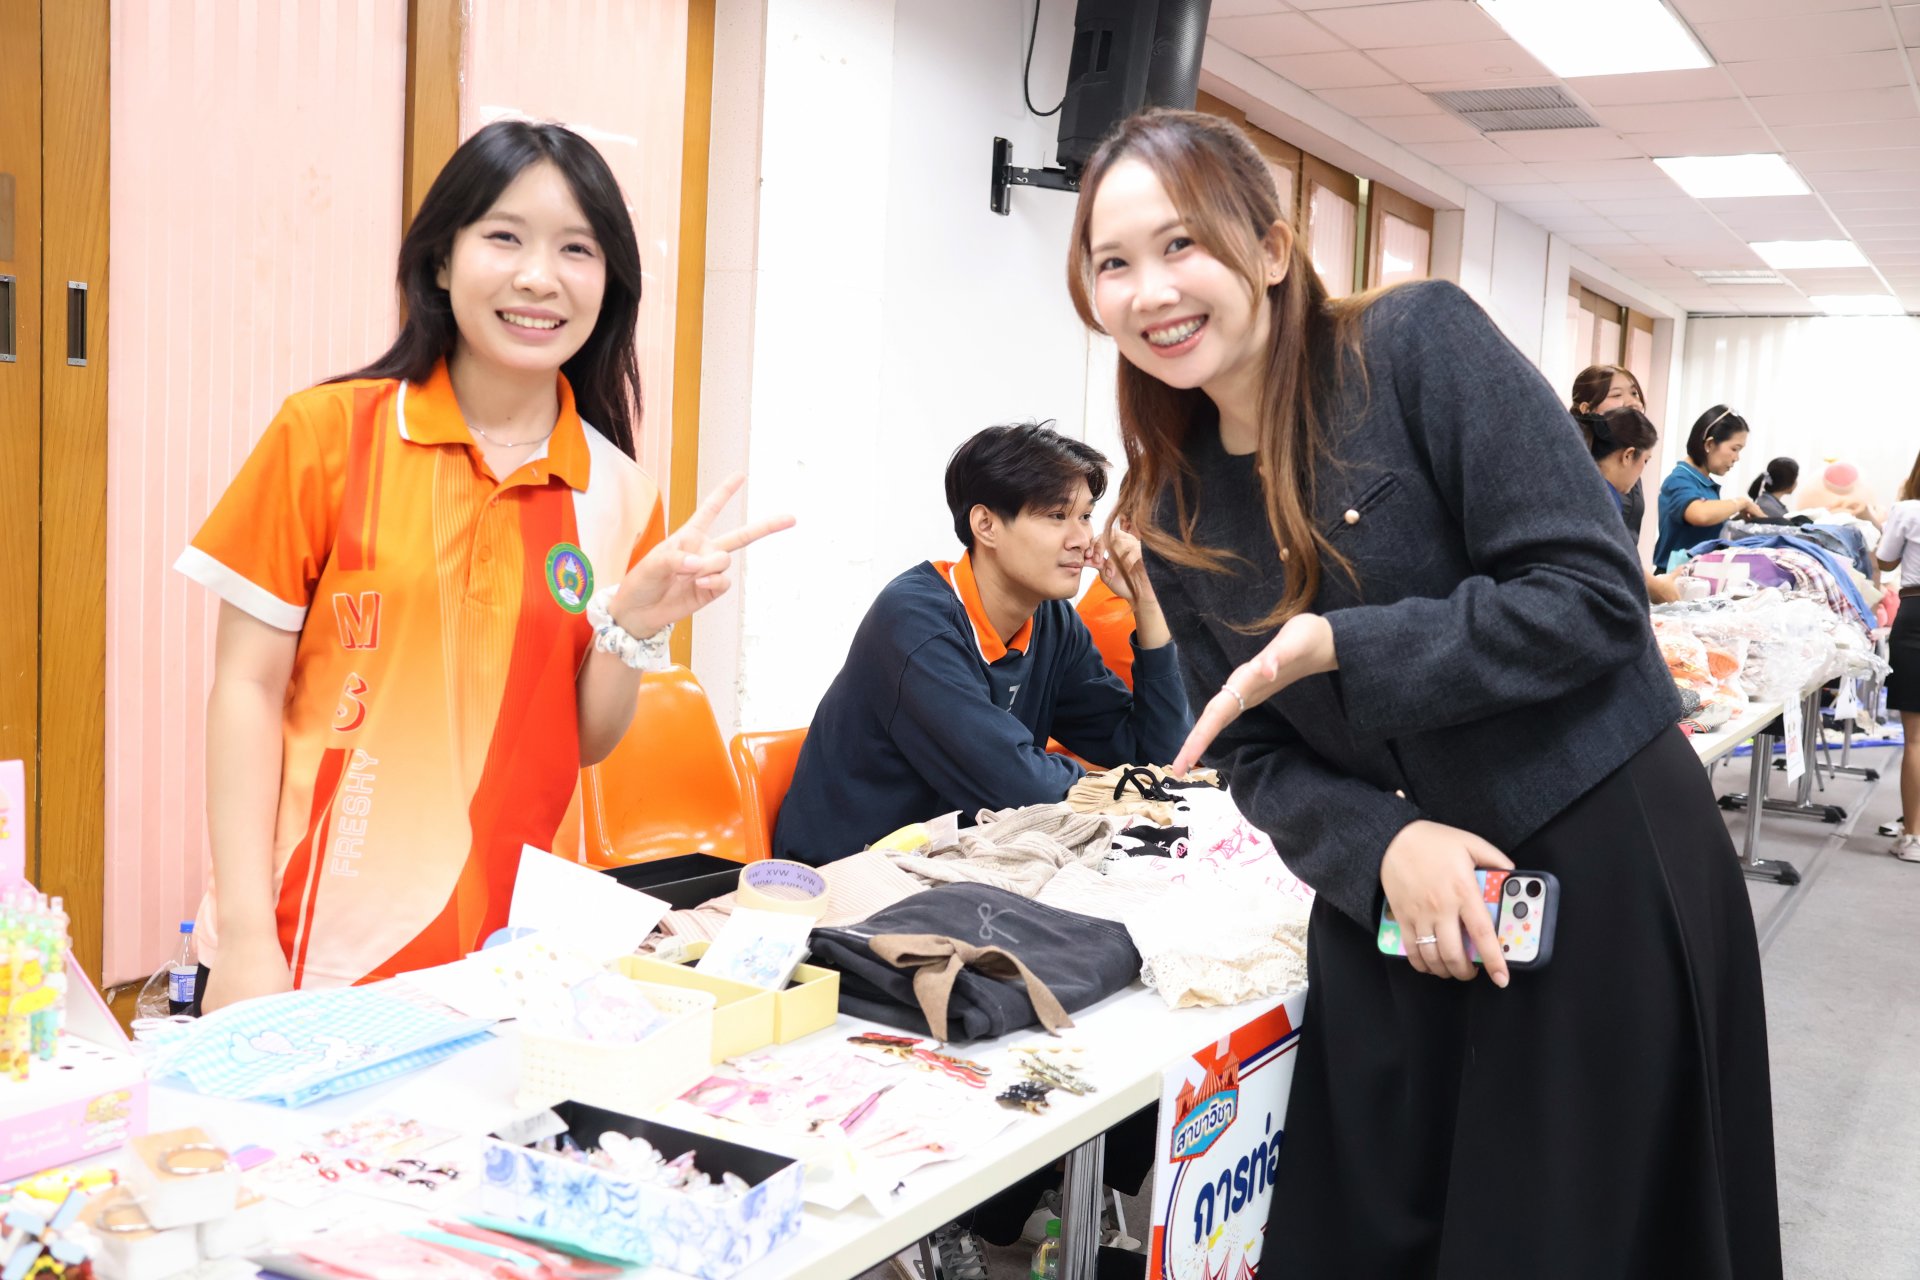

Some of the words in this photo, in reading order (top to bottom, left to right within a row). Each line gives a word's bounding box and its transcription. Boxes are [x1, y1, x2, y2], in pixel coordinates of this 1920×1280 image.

[330, 747, 379, 878] FRESHY
[1176, 1102, 1232, 1153] สาขาวิชา
